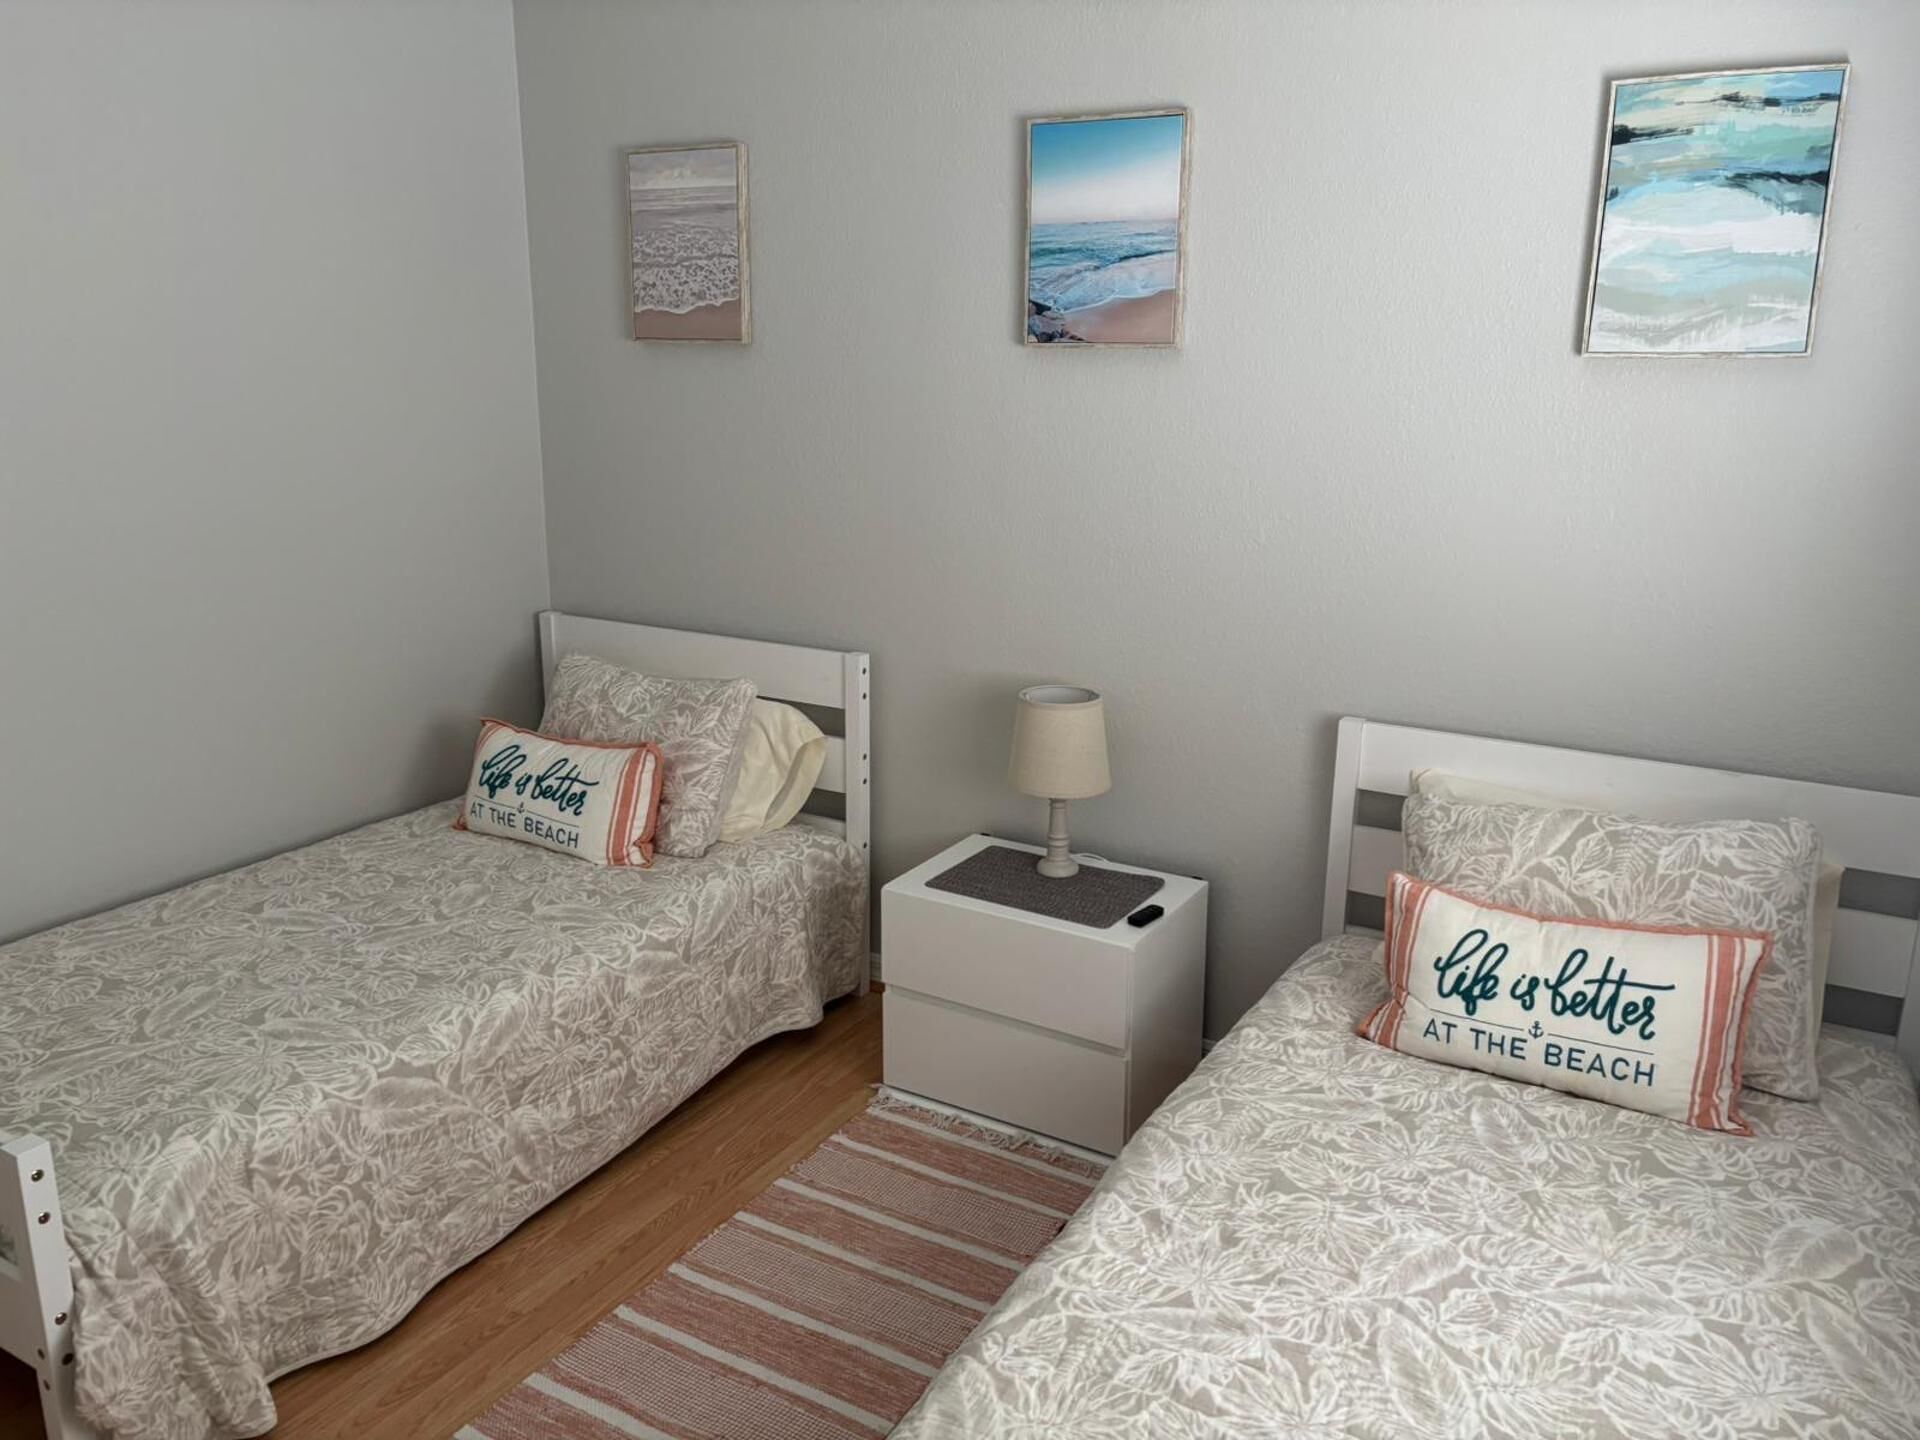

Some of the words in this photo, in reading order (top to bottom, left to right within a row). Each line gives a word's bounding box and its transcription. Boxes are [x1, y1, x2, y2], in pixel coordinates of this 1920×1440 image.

[515, 772, 533, 796] is
[530, 757, 600, 816] better
[469, 801, 484, 819] AT
[489, 806, 517, 829] THE
[523, 816, 580, 849] BEACH
[1510, 972, 1541, 1011] is
[1543, 948, 1676, 1041] better
[1422, 1017, 1458, 1045] AT
[1469, 1027, 1528, 1061] THE
[1543, 1043, 1656, 1088] BEACH
